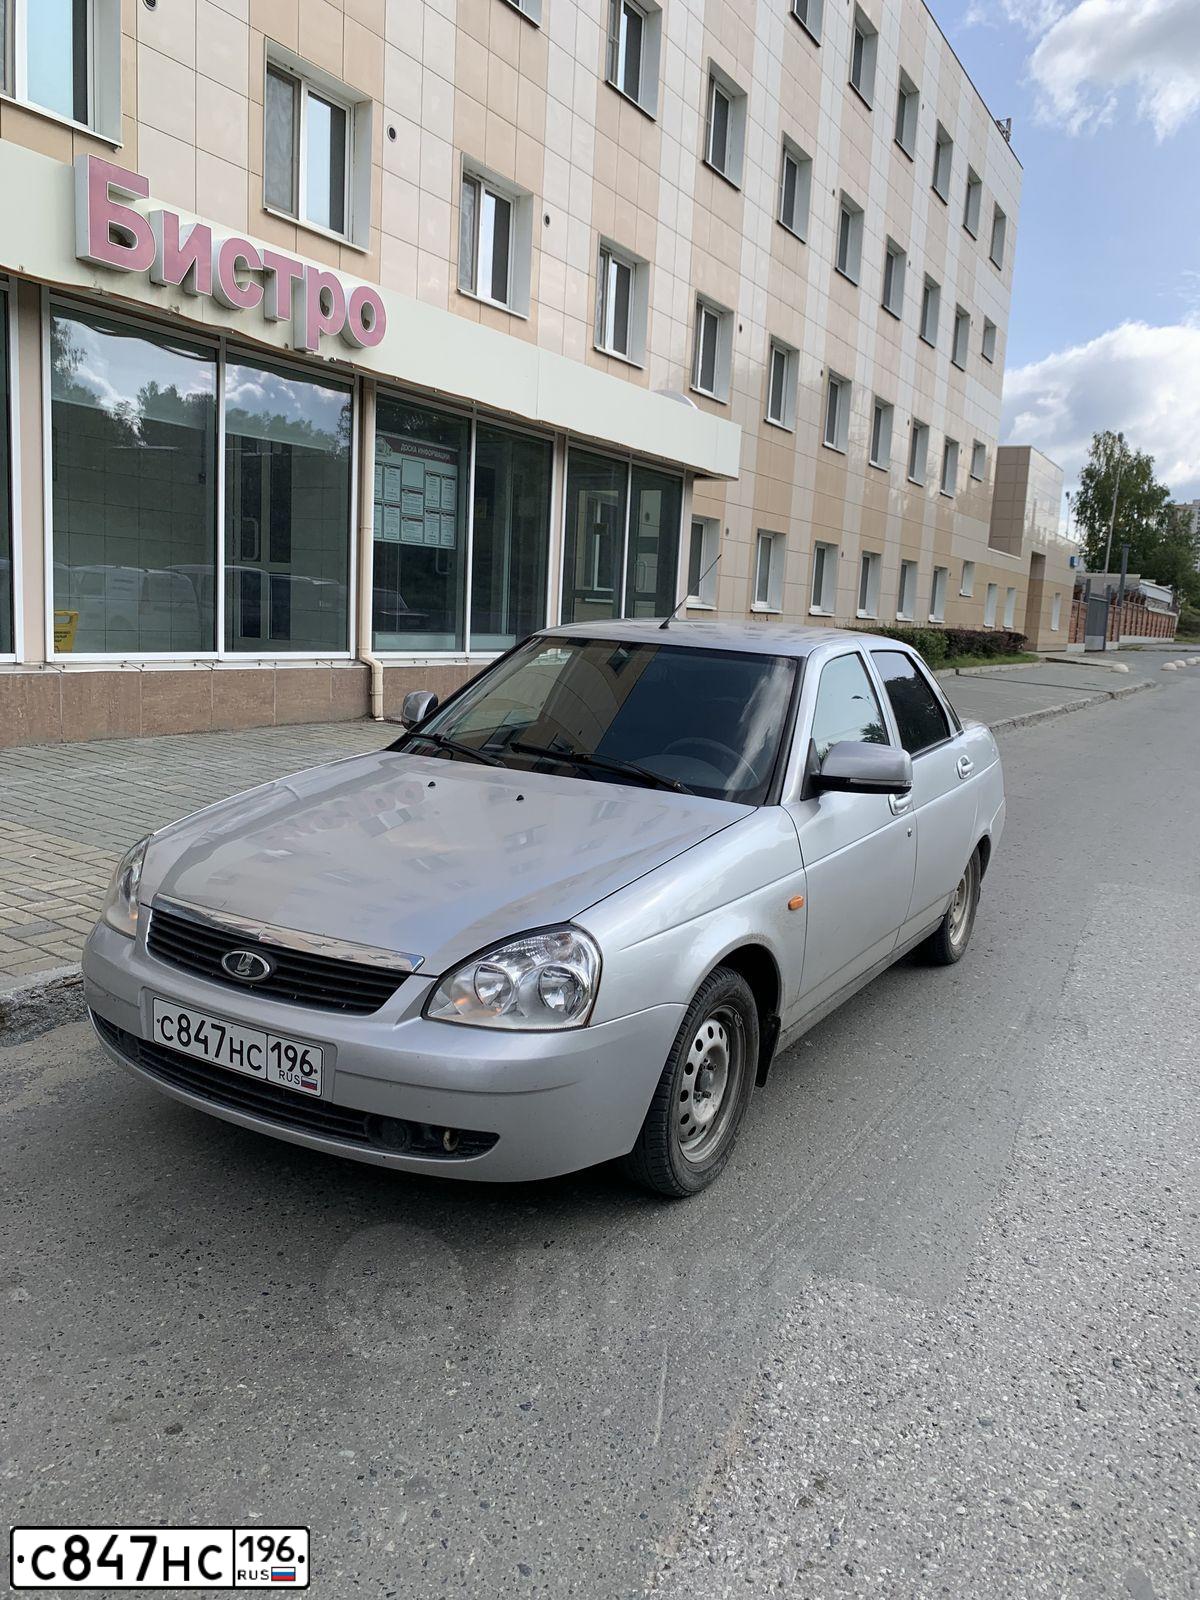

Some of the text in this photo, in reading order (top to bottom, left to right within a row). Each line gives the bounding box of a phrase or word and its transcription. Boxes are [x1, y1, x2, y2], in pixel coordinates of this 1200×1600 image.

[80, 154, 387, 351] Бистро
[270, 1041, 314, 1077] 196
[278, 1069, 301, 1085] RUS
